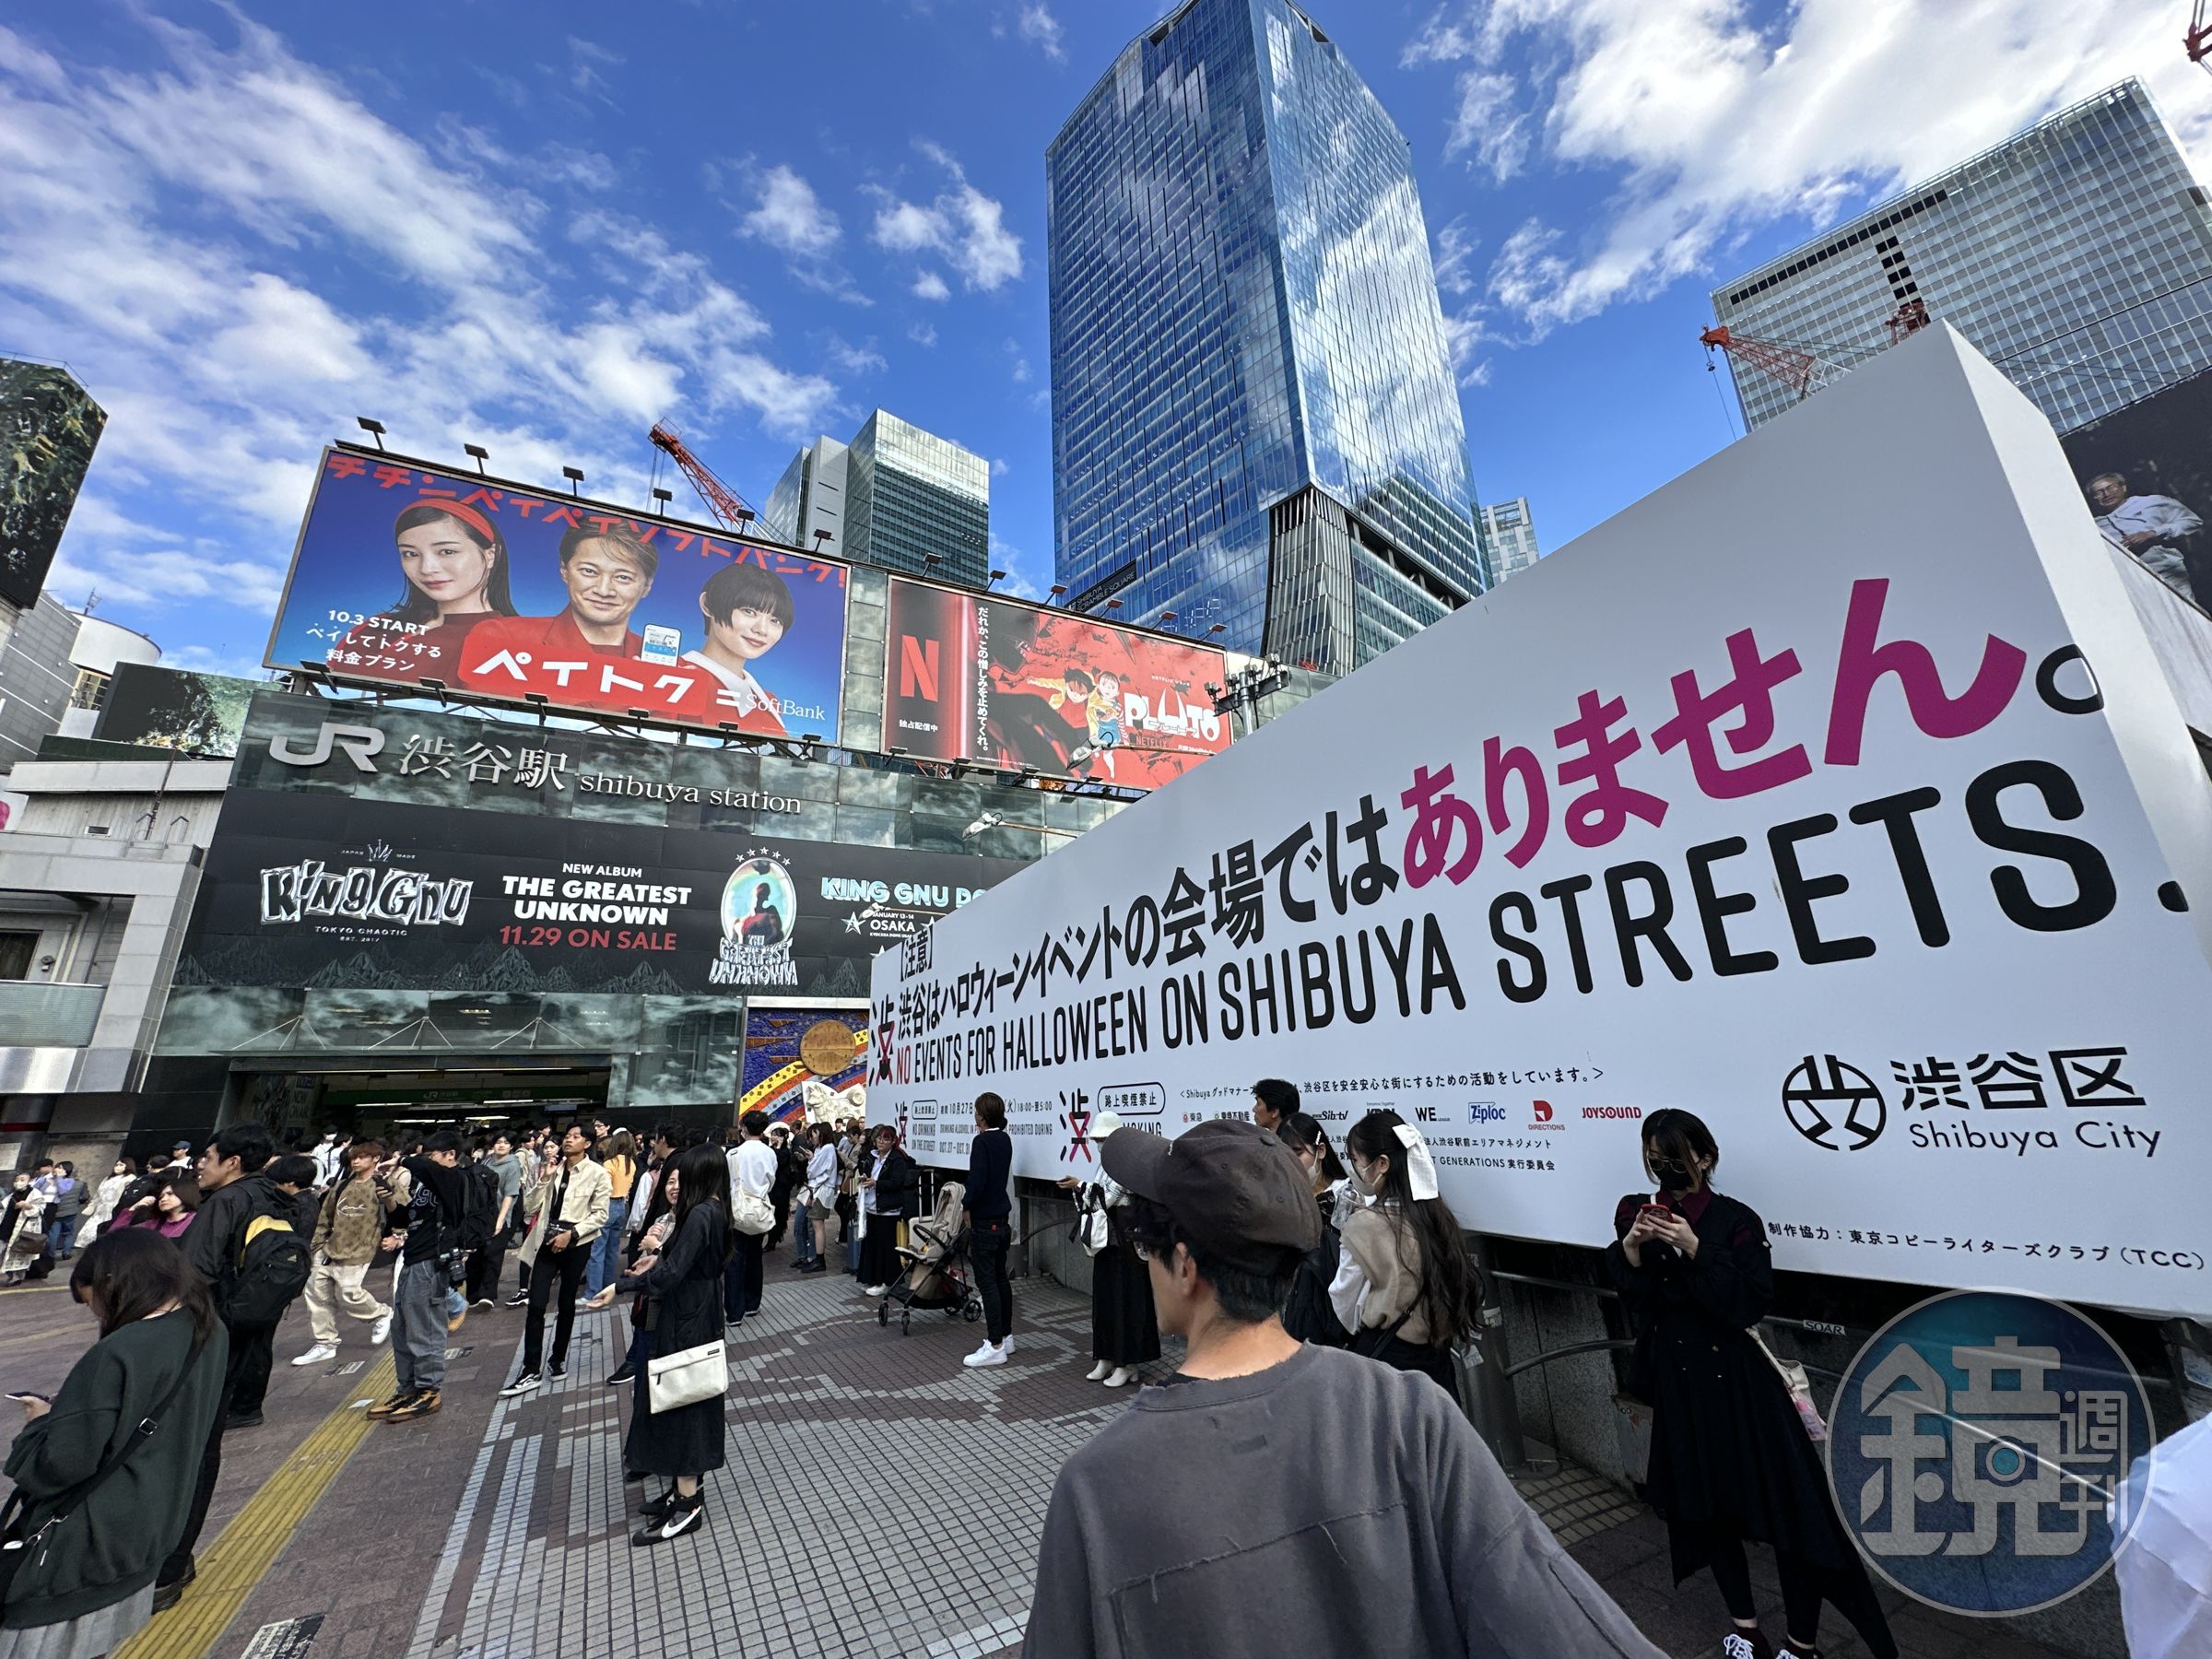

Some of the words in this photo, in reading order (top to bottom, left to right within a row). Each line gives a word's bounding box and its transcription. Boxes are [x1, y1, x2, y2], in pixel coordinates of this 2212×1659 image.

[1109, 572, 1135, 593] SQUARE
[328, 609, 364, 626] 10.3
[369, 617, 429, 636] START
[306, 623, 442, 658] ペイしてトクする
[325, 648, 415, 672] 料金プラン
[976, 606, 989, 752] だれか、この憎しみを止めてくれ。
[745, 693, 826, 722] SoftBank
[1124, 687, 1220, 742] PLUTO
[899, 719, 938, 733] 独占配信中
[268, 722, 385, 772] JR
[398, 734, 570, 793] 渋谷駅
[580, 772, 700, 805] shibuya
[710, 785, 802, 815] station
[562, 862, 594, 875] NEW
[595, 865, 642, 878] ALBUM
[502, 875, 556, 898] THE
[561, 879, 692, 905] GREATEST
[821, 877, 890, 904] KING
[893, 882, 949, 909] GNU
[513, 900, 669, 926] UNKNOWN
[896, 1044, 911, 1086] NO
[914, 1032, 962, 1084] EVENTS
[967, 1024, 996, 1077] FOR
[1003, 984, 1148, 1073] HALLOWEEN
[1160, 969, 1209, 1050] ON
[1218, 912, 1466, 1041] SHIBUYA
[1488, 759, 2190, 1004] STREETS.
[314, 925, 354, 935] TOKYO
[358, 927, 407, 936] CHAOTIC
[499, 925, 562, 947] 11.29
[568, 928, 610, 949] ON
[617, 930, 677, 951] SALE
[869, 919, 916, 933] OSAKA
[1889, 1046, 2147, 1112] 渋谷区
[1104, 1091, 1157, 1109] 路上喫煙禁止
[1582, 1106, 1642, 1119] JOYSOUND
[1415, 1106, 1438, 1122] WE
[1470, 1104, 1506, 1124] Ziploc
[1034, 1123, 1053, 1135] DURING
[1909, 1120, 2058, 1157] Shibuya
[2075, 1121, 2161, 1158] City
[1440, 1156, 1505, 1169] GENERATIONS
[1507, 1159, 1555, 1171] 実行委員会
[1804, 1320, 1843, 1335] SOAR
